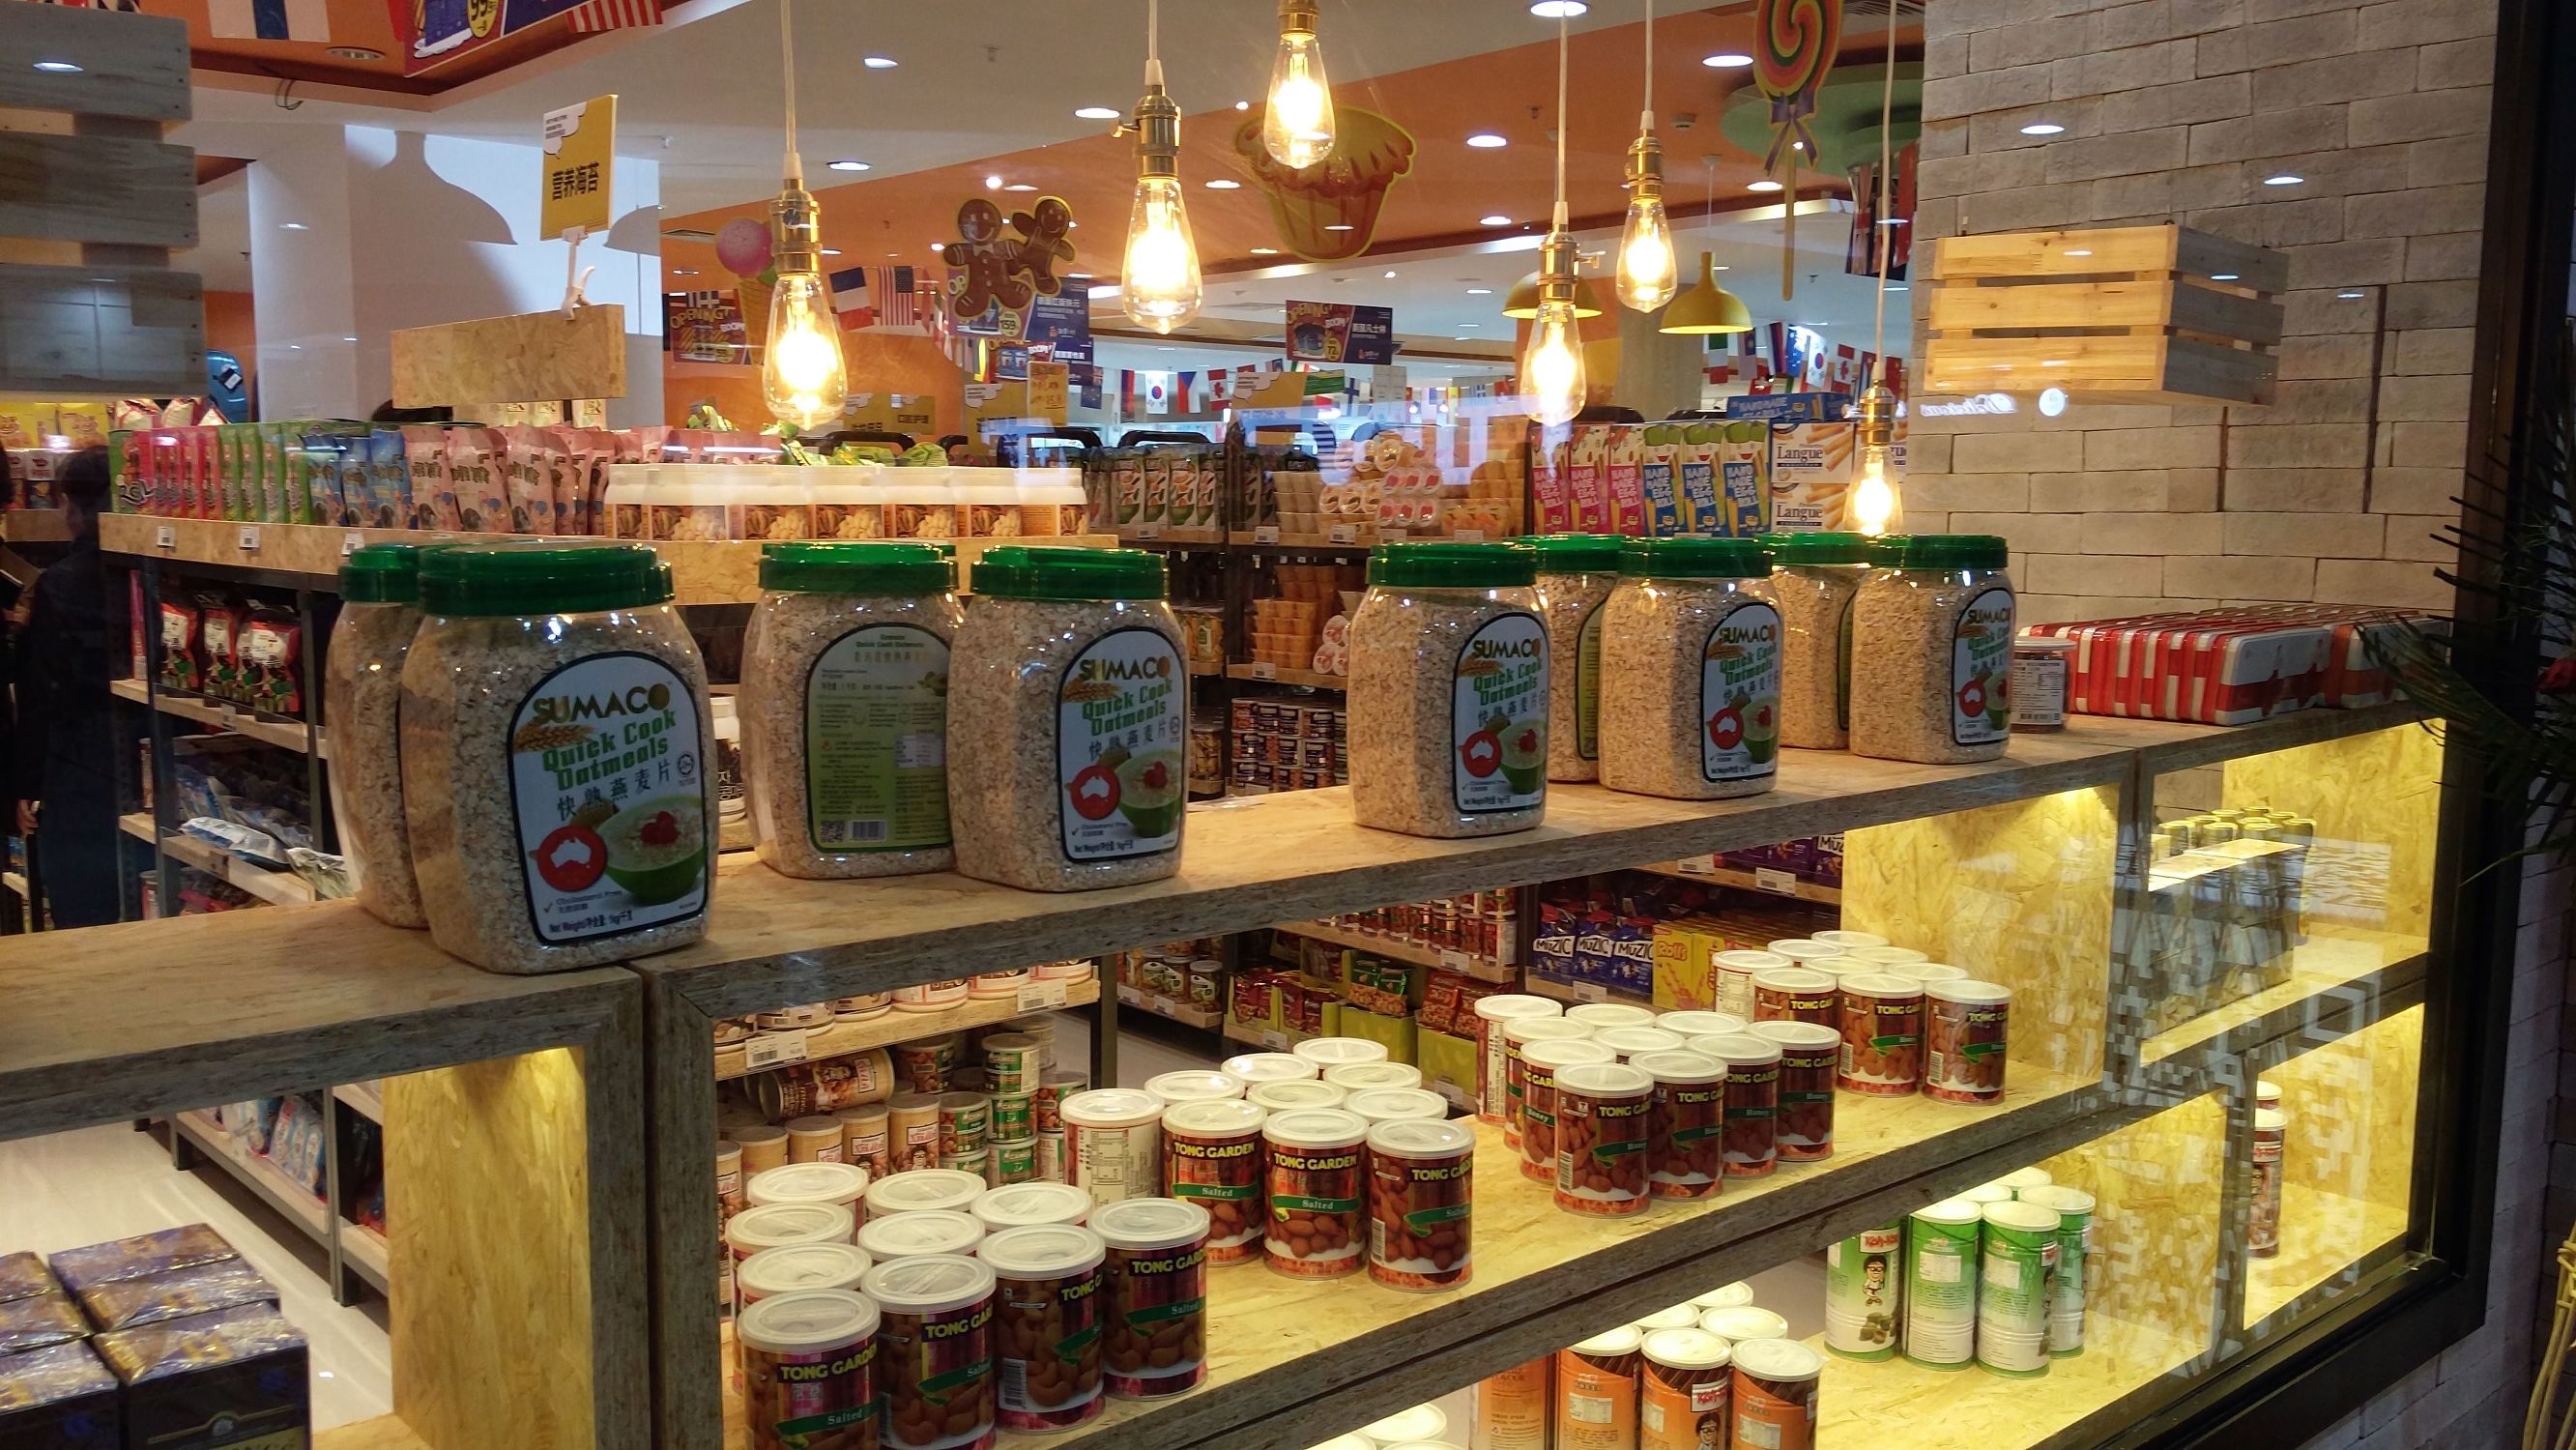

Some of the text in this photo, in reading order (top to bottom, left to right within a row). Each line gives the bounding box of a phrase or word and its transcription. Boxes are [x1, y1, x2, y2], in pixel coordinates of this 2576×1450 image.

[1777, 446, 1823, 462] Langue
[1777, 504, 1823, 520] Langue
[1473, 638, 1541, 658] SUMACO
[1079, 656, 1172, 682] SUMACO
[534, 682, 671, 725] SUMACO
[1083, 678, 1172, 721] Quick Cook
[1091, 700, 1167, 736] Oatmeals
[542, 709, 677, 771] Quick Cook
[556, 737, 670, 792] Oatmeals
[1818, 833, 1845, 852] MUZ
[1790, 1000, 1817, 1010] TONG
[1876, 1004, 1904, 1015] TONG
[1780, 1058, 1812, 1068] TONG
[1532, 1074, 1555, 1088] GAR
[1726, 1069, 1780, 1084] ONG GARD
[1676, 1091, 1709, 1104] TONG
[1598, 1105, 1632, 1117] TONG
[1174, 1142, 1256, 1159] TONG GARDEN
[1274, 1152, 1358, 1171] TONG GARDEN
[1411, 1168, 1449, 1181] TONG
[1201, 1186, 1234, 1198] Salted
[1301, 1200, 1334, 1210] Salted
[1132, 1249, 1207, 1274] TONG GARD
[1061, 1280, 1095, 1302] TONG
[924, 1303, 995, 1340] TONG GAR
[780, 1364, 828, 1381] TONG
[826, 1409, 863, 1426] Salted
